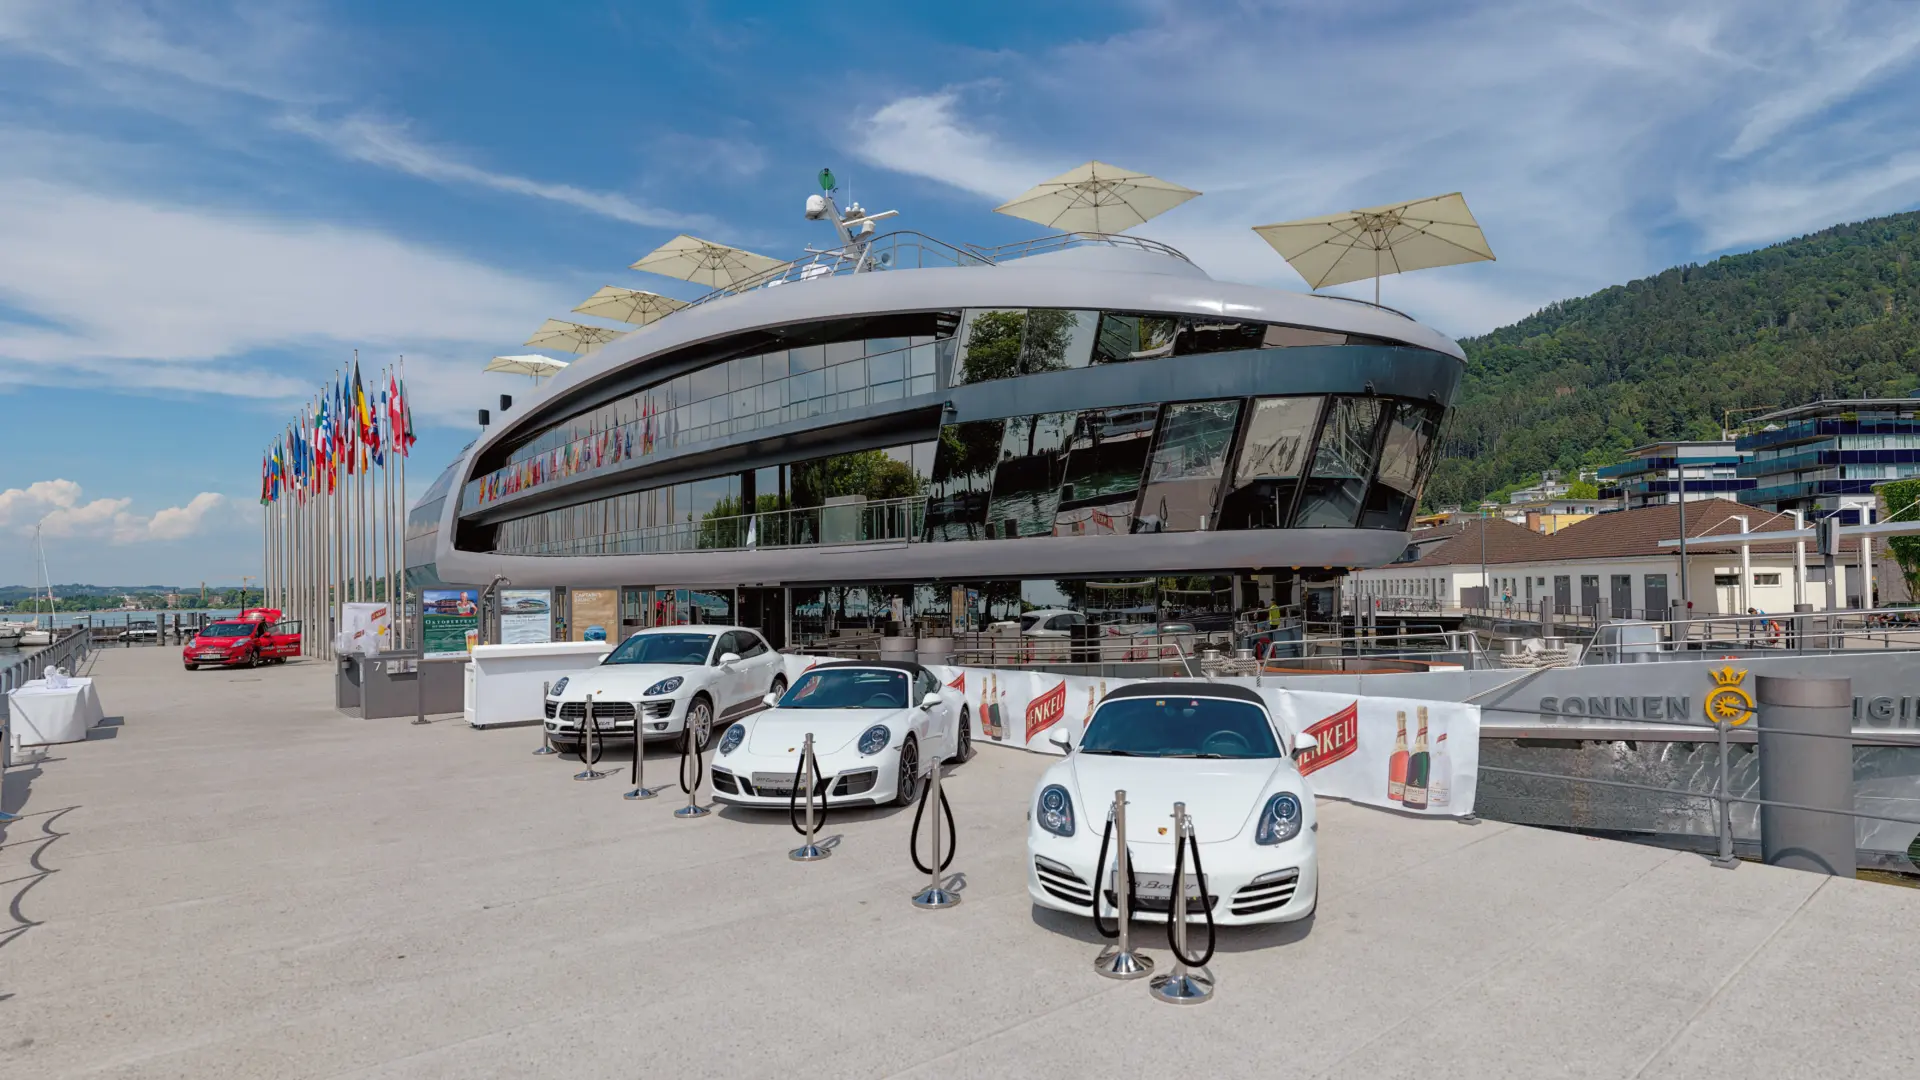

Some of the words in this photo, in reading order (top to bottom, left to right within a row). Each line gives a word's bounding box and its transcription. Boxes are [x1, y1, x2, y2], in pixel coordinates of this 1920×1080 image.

[373, 661, 382, 672] 7
[1540, 696, 1690, 719] SONNEN
[1853, 695, 1920, 720] IGI
